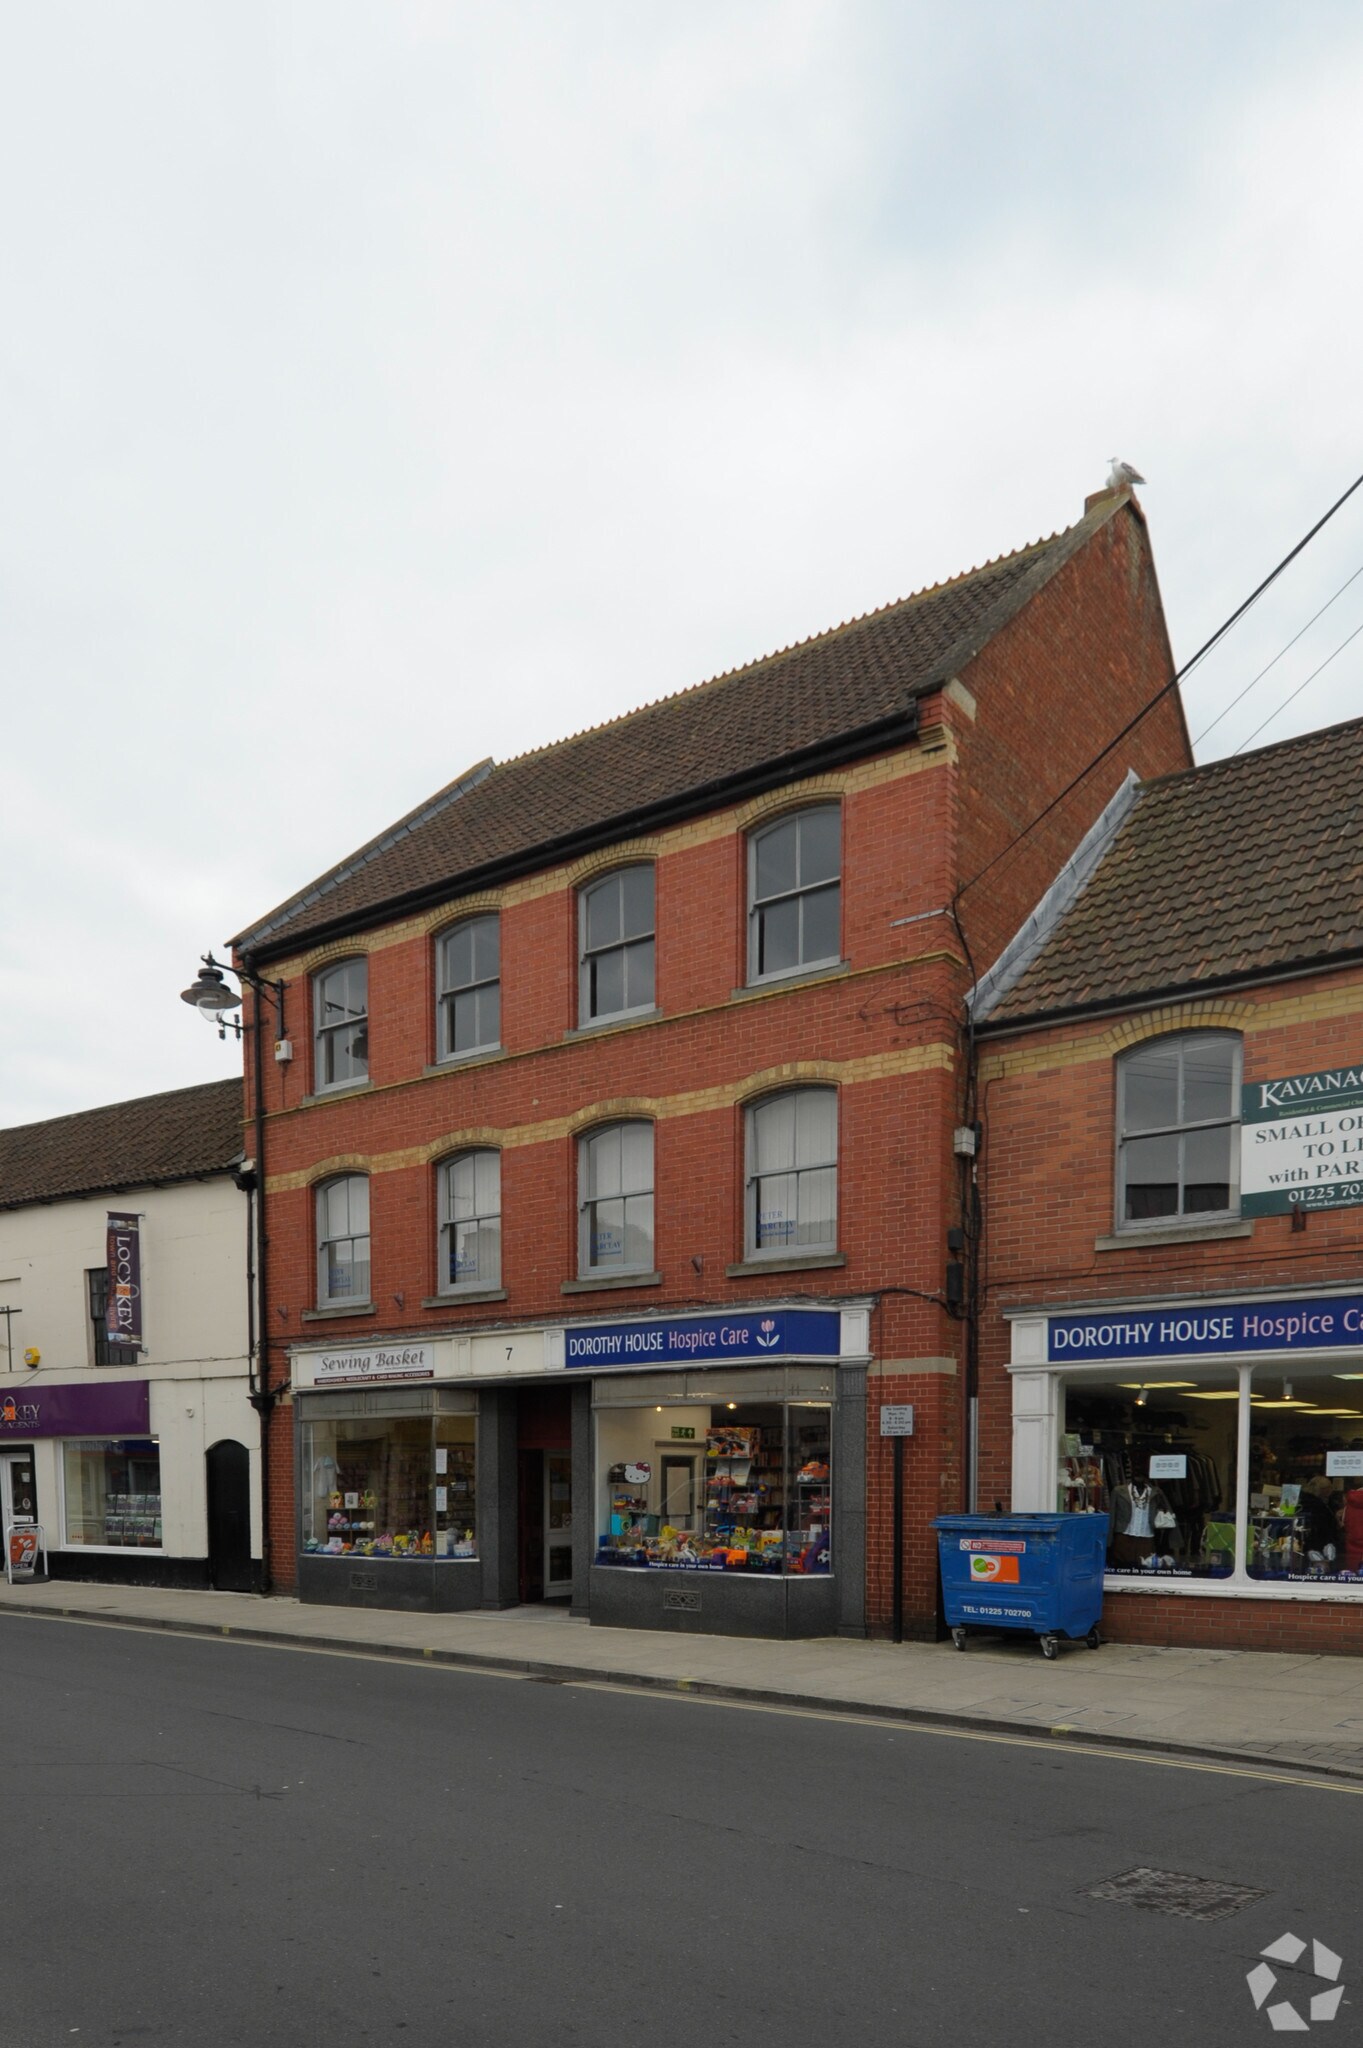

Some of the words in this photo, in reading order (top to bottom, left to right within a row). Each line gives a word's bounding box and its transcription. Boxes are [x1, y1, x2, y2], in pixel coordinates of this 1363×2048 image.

[1256, 1120, 1333, 1144] SMALL
[1303, 1141, 1335, 1159] TO
[1269, 1167, 1309, 1184] with
[1316, 1159, 1363, 1179] PAR
[1288, 1186, 1336, 1203] 01225
[109, 1235, 117, 1258] town
[110, 1259, 118, 1276] and
[1053, 1322, 1153, 1349] DOROTHY
[1159, 1317, 1234, 1343] HOUSE
[1243, 1311, 1334, 1342] Hospice
[569, 1335, 623, 1356] DOROTHY
[625, 1332, 664, 1352] HOUSE
[668, 1329, 716, 1353] Hospice
[720, 1327, 749, 1346] Care
[321, 1355, 371, 1373] Sewing
[375, 1348, 425, 1368] Basket
[505, 1347, 514, 1361] 7
[649, 1561, 667, 1569] Hospice
[1288, 1573, 1318, 1581] Hospice
[980, 1607, 1002, 1615] 01225
[1003, 1609, 1032, 1617] 702700
